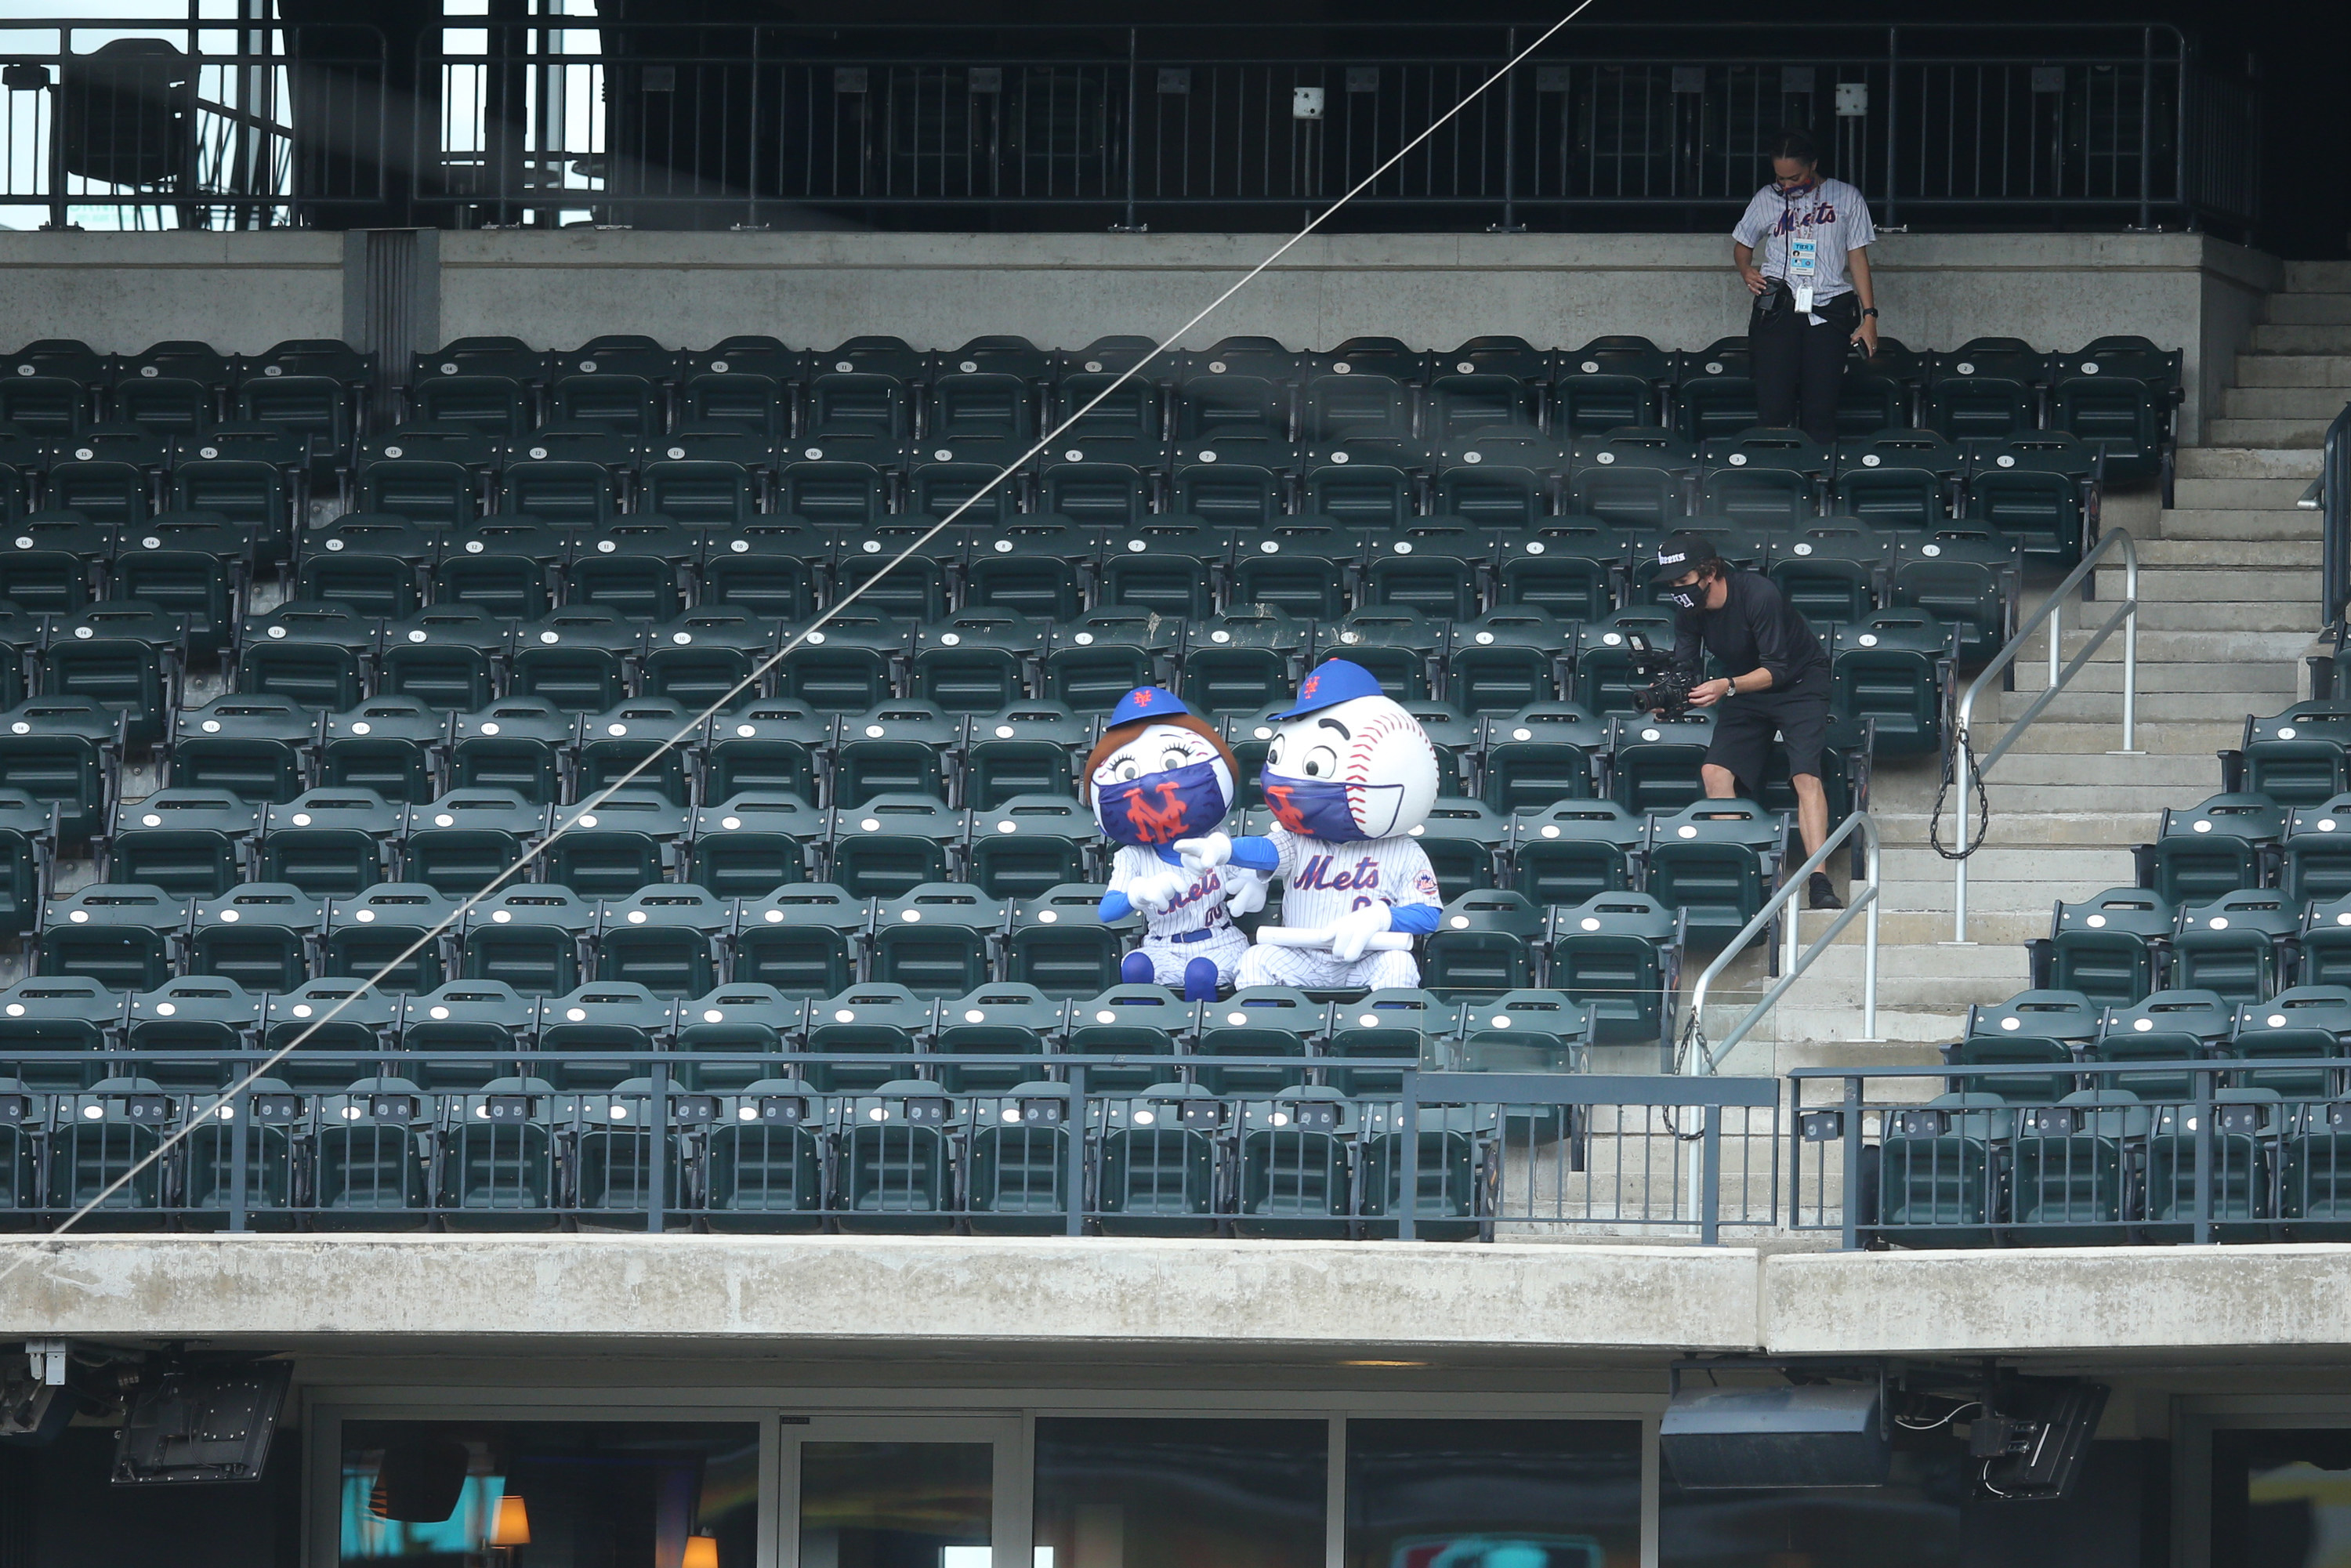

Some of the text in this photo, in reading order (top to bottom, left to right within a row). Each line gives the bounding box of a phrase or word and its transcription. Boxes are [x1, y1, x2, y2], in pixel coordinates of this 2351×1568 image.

[1773, 201, 1837, 238] Mets
[1133, 690, 1153, 708] NY
[1293, 855, 1379, 891] Mets
